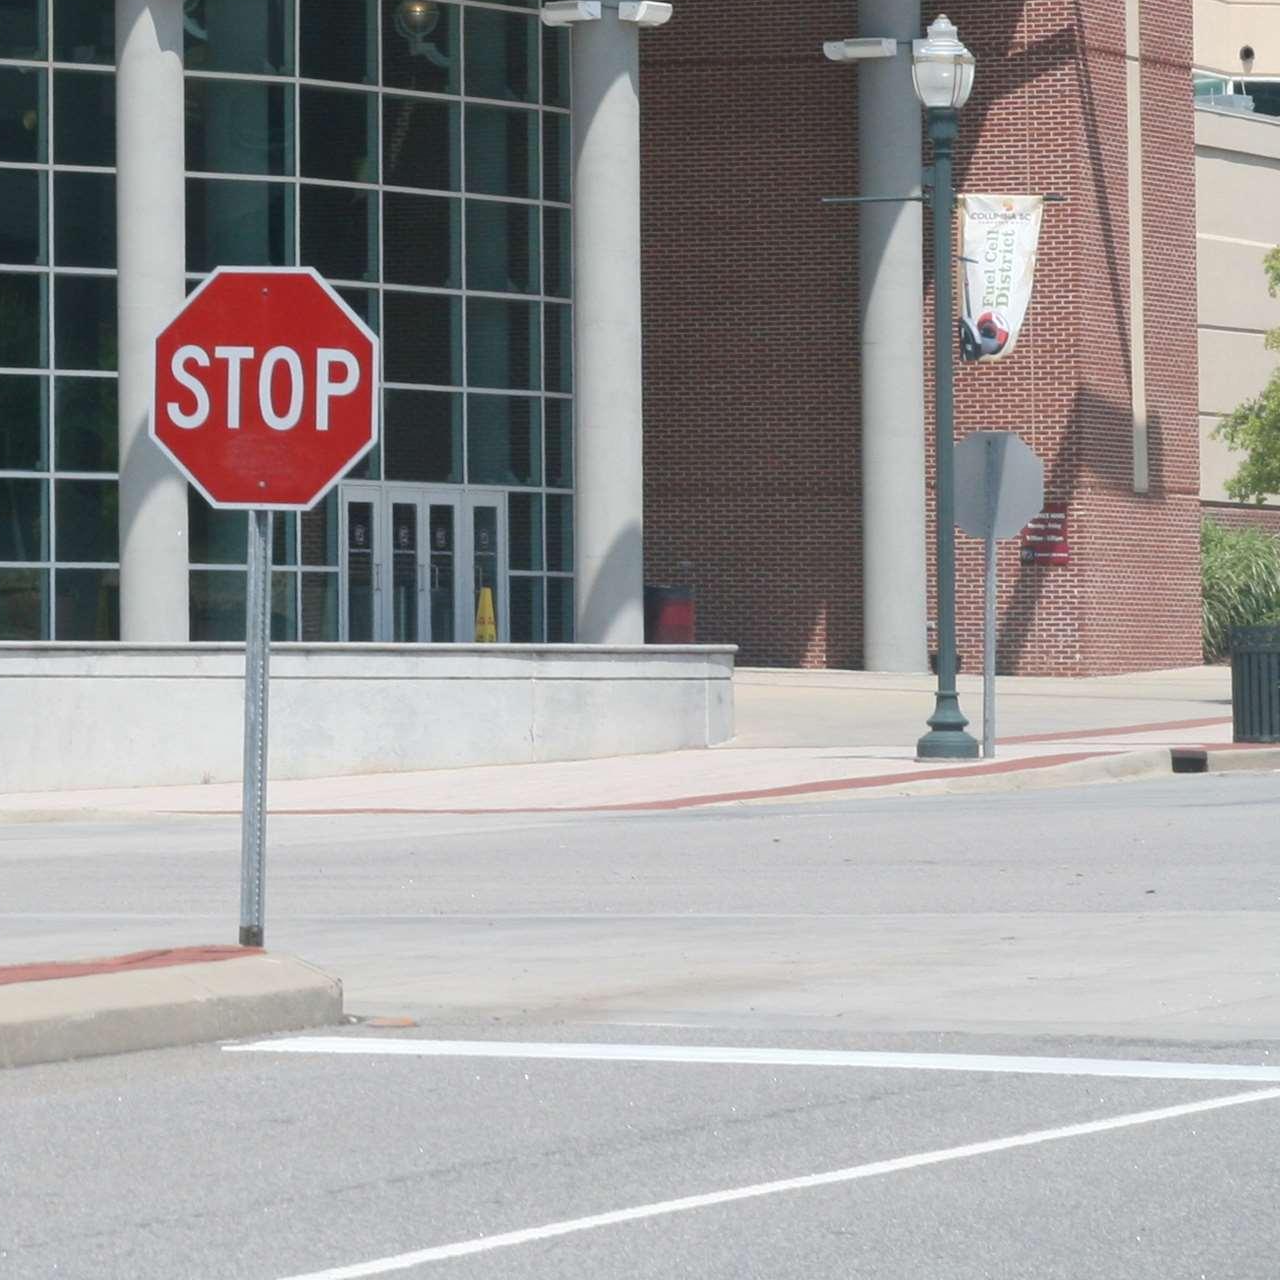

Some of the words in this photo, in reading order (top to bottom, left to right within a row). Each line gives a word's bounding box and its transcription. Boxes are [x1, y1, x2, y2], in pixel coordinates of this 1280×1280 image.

[984, 229, 1000, 263] Cell
[995, 229, 1016, 308] District
[982, 269, 997, 308] Fuel
[166, 344, 361, 431] STOP
